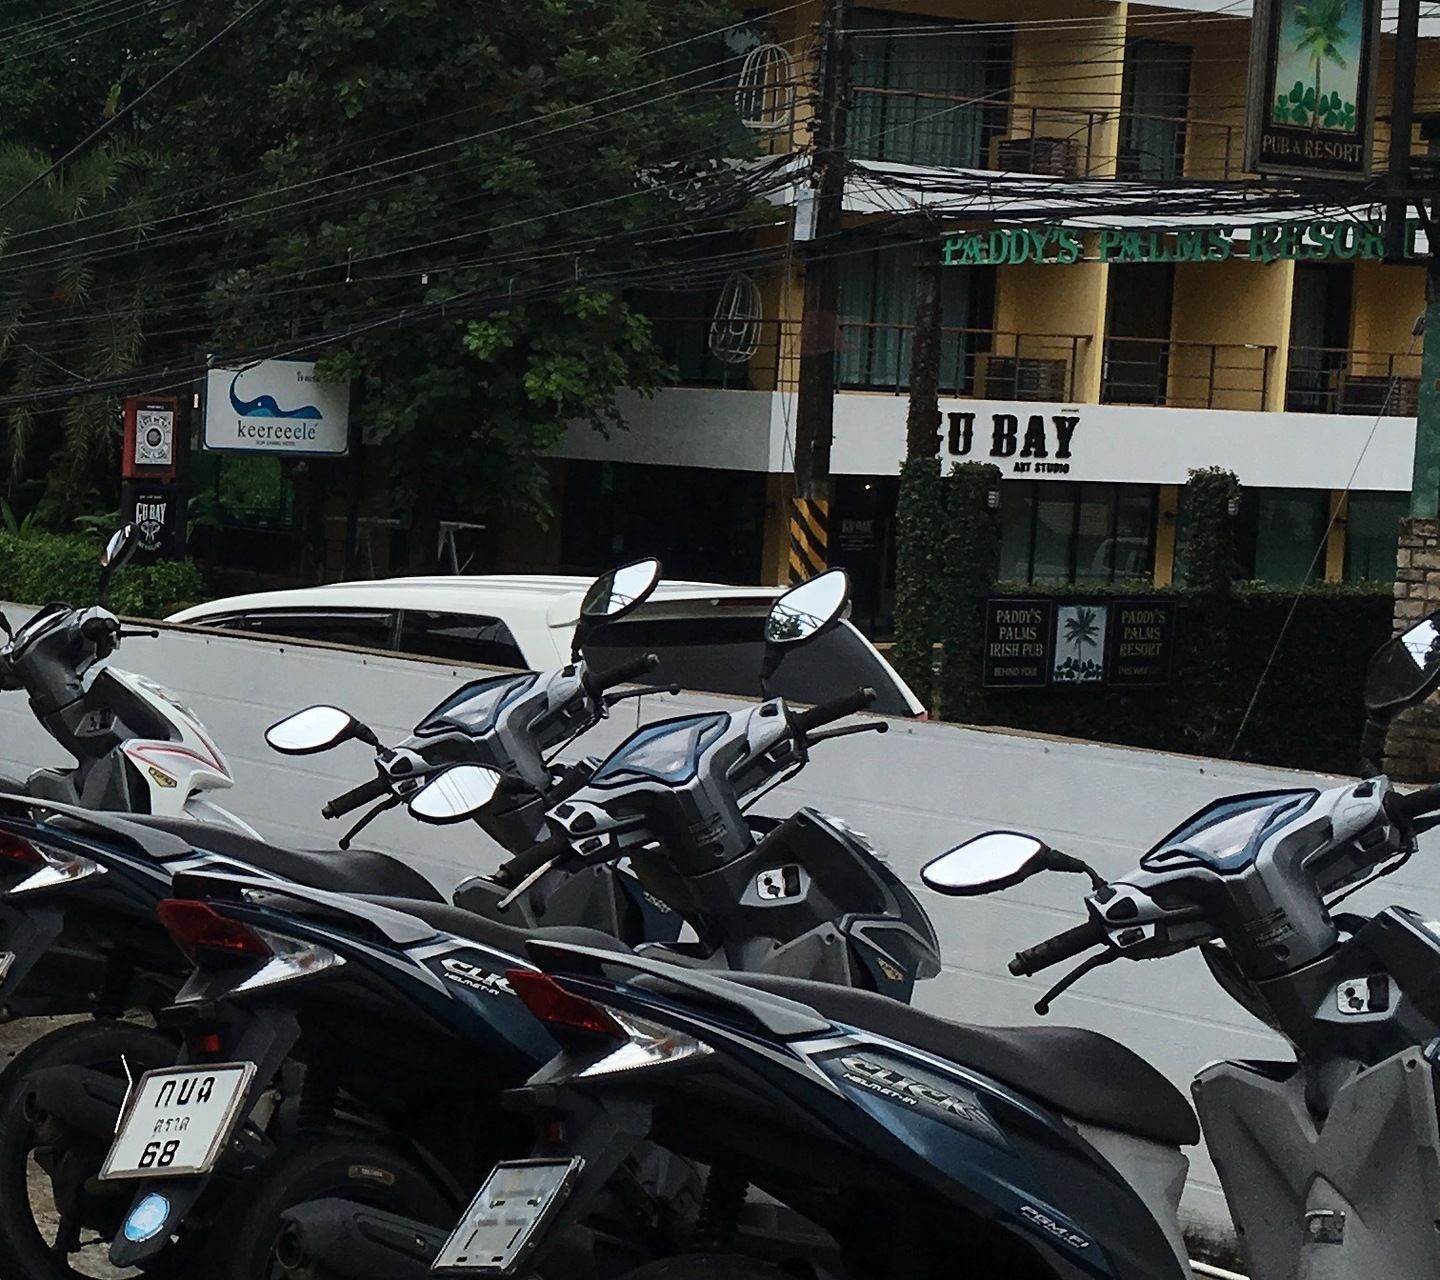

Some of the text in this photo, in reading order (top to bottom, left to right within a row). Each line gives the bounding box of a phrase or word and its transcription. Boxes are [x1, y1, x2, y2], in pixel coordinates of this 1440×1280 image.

[1262, 134, 1290, 154] PUB
[1304, 139, 1363, 162] RESORT
[942, 226, 1082, 266] PADDY'S
[1098, 224, 1232, 265] PALMS
[989, 414, 1081, 459] BAY
[1013, 461, 1070, 474] ART STUDIO
[135, 502, 167, 525] GU BAY
[996, 608, 1042, 624] PADDY'S
[1121, 609, 1166, 625] PADDY'S
[999, 626, 1037, 641] PALMS
[1124, 626, 1161, 641] PALMS
[990, 642, 1043, 658] IRISH PUB
[1119, 642, 1163, 658] RESORT
[441, 958, 517, 996] CLIC
[154, 1076, 216, 1108] กบฉ
[841, 1056, 974, 1121] CLICK
[842, 1072, 919, 1106] HELMET-IN
[153, 1116, 191, 1133] ตราด
[137, 1139, 181, 1169] 68
